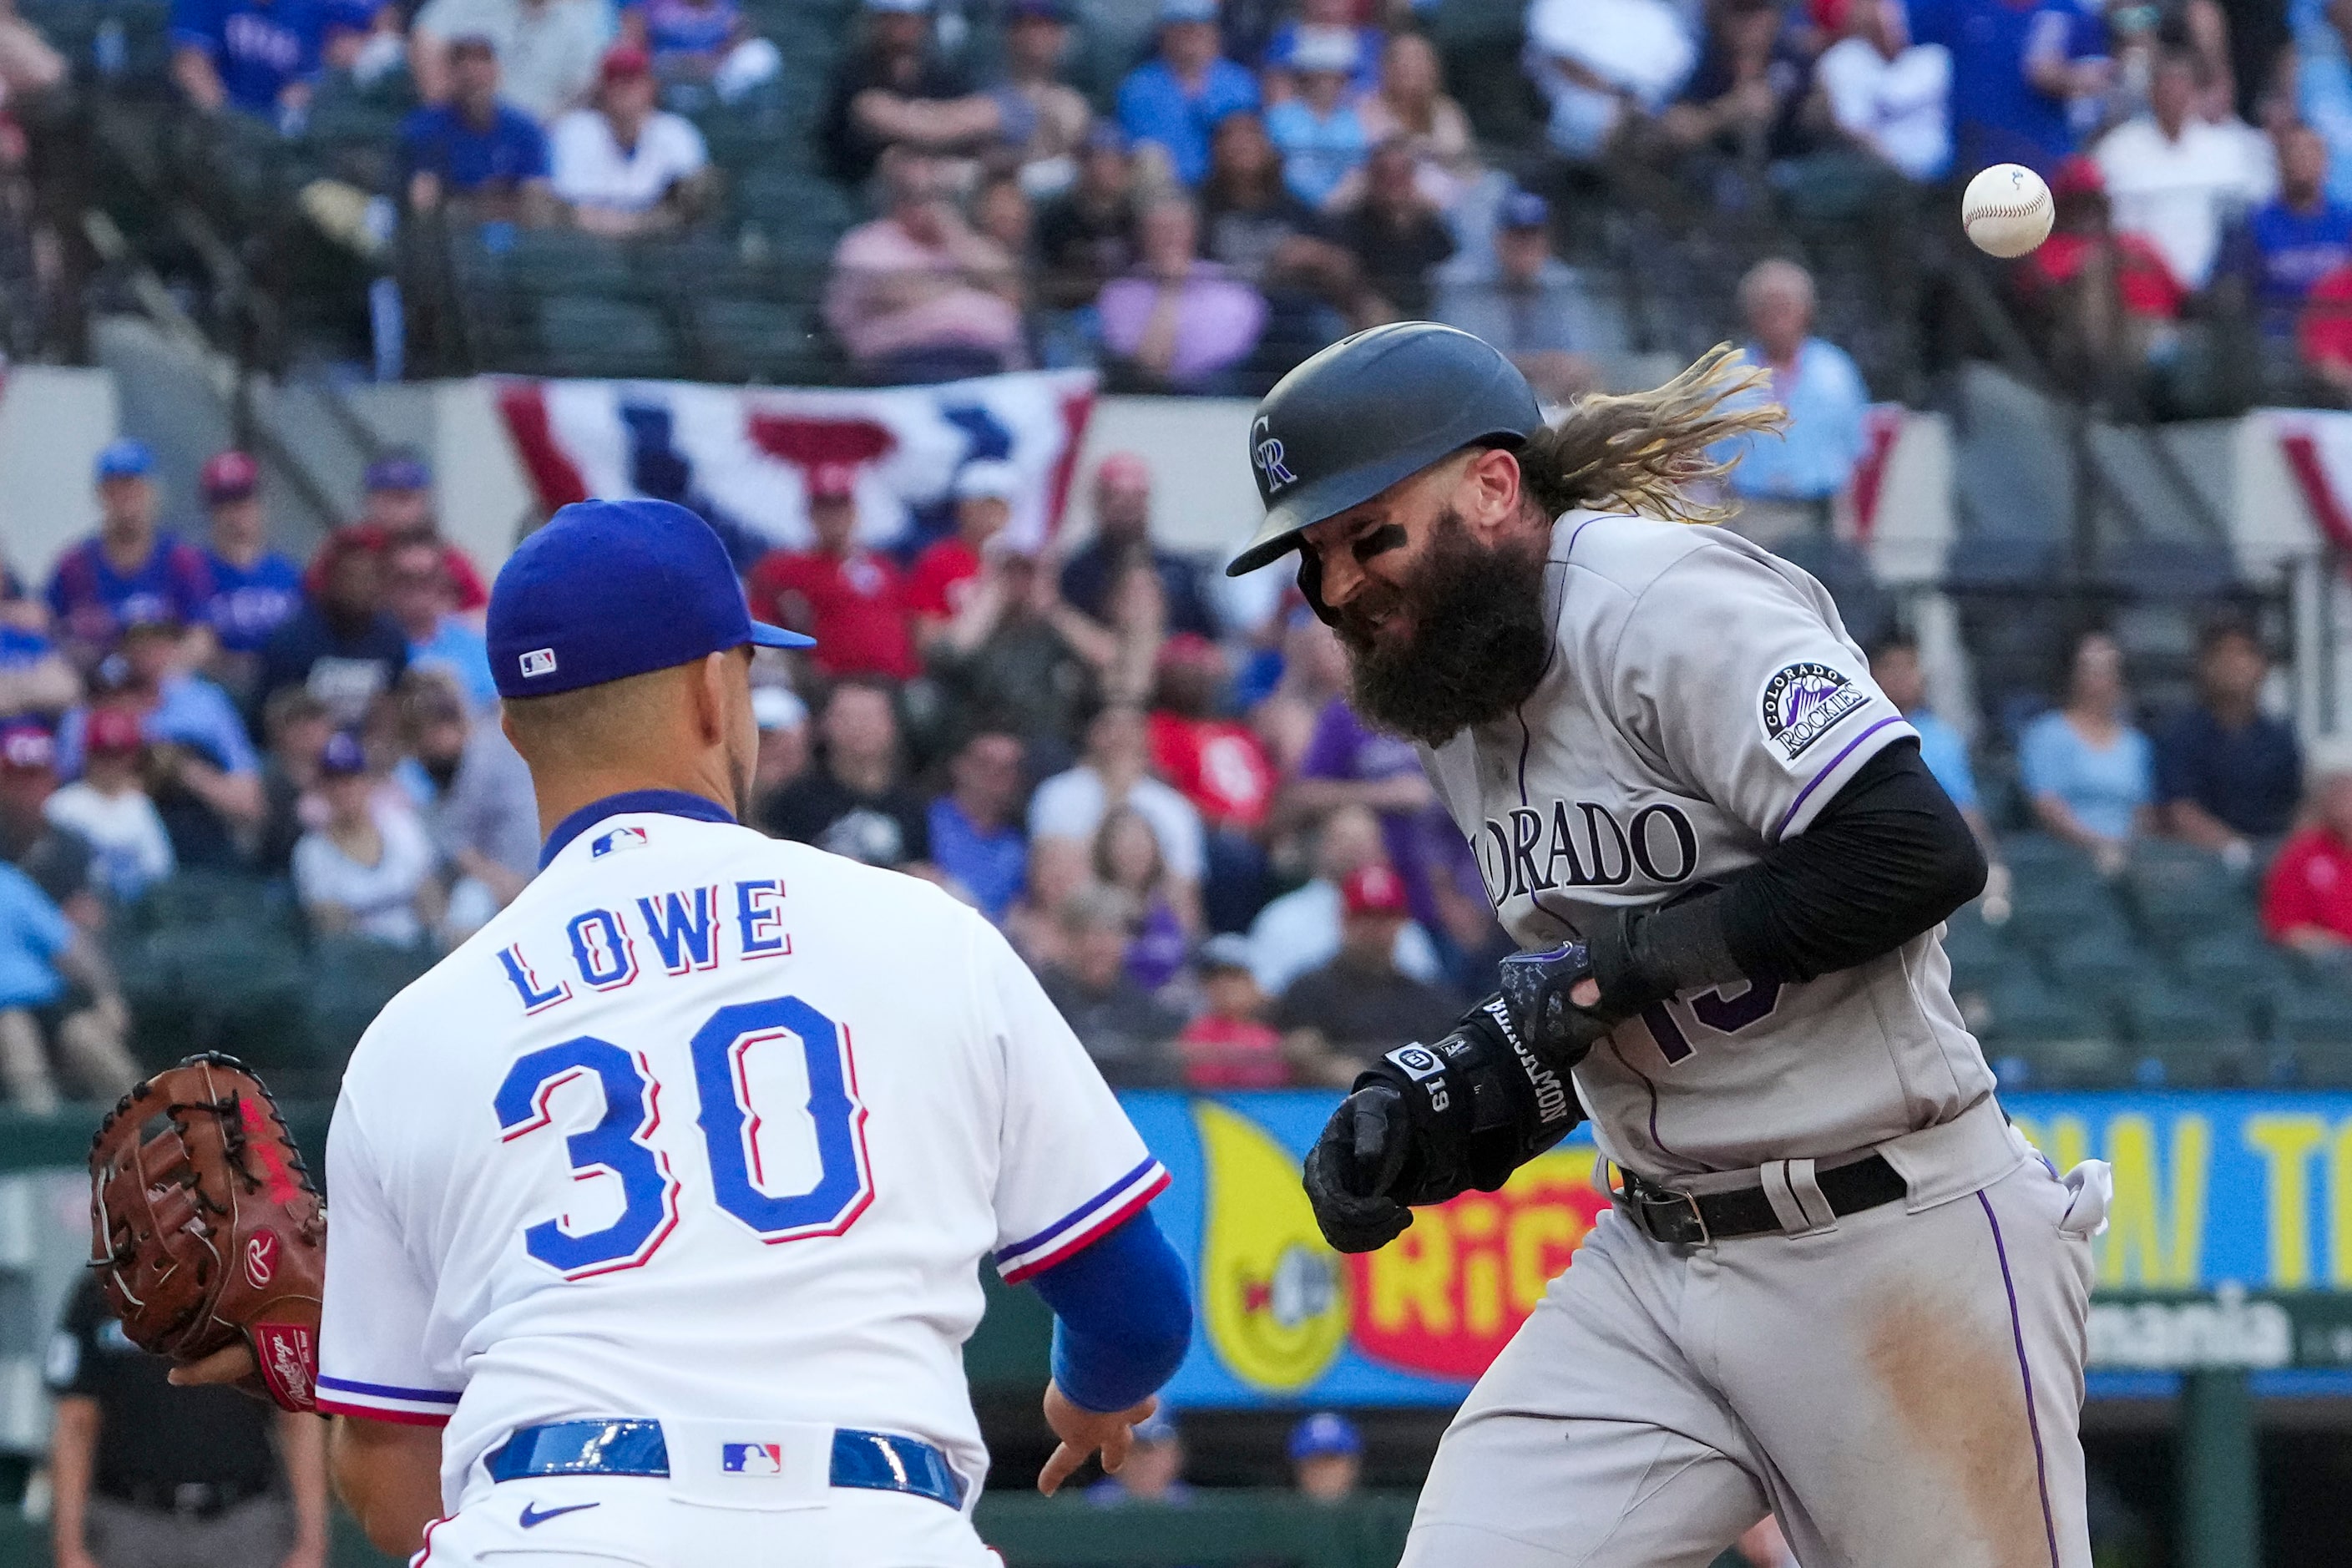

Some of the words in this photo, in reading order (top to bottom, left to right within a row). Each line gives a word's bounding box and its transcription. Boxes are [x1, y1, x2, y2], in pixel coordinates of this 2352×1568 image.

[1765, 664, 1839, 726] COLORADO
[1776, 682, 1864, 755] ROCKIES
[493, 878, 792, 1017] LOWE
[1424, 1076, 1450, 1112] 19
[492, 994, 876, 1282] 30
[2246, 1113, 2352, 1290] T
[244, 1236, 273, 1290] R
[274, 1333, 315, 1406] Rawlings
